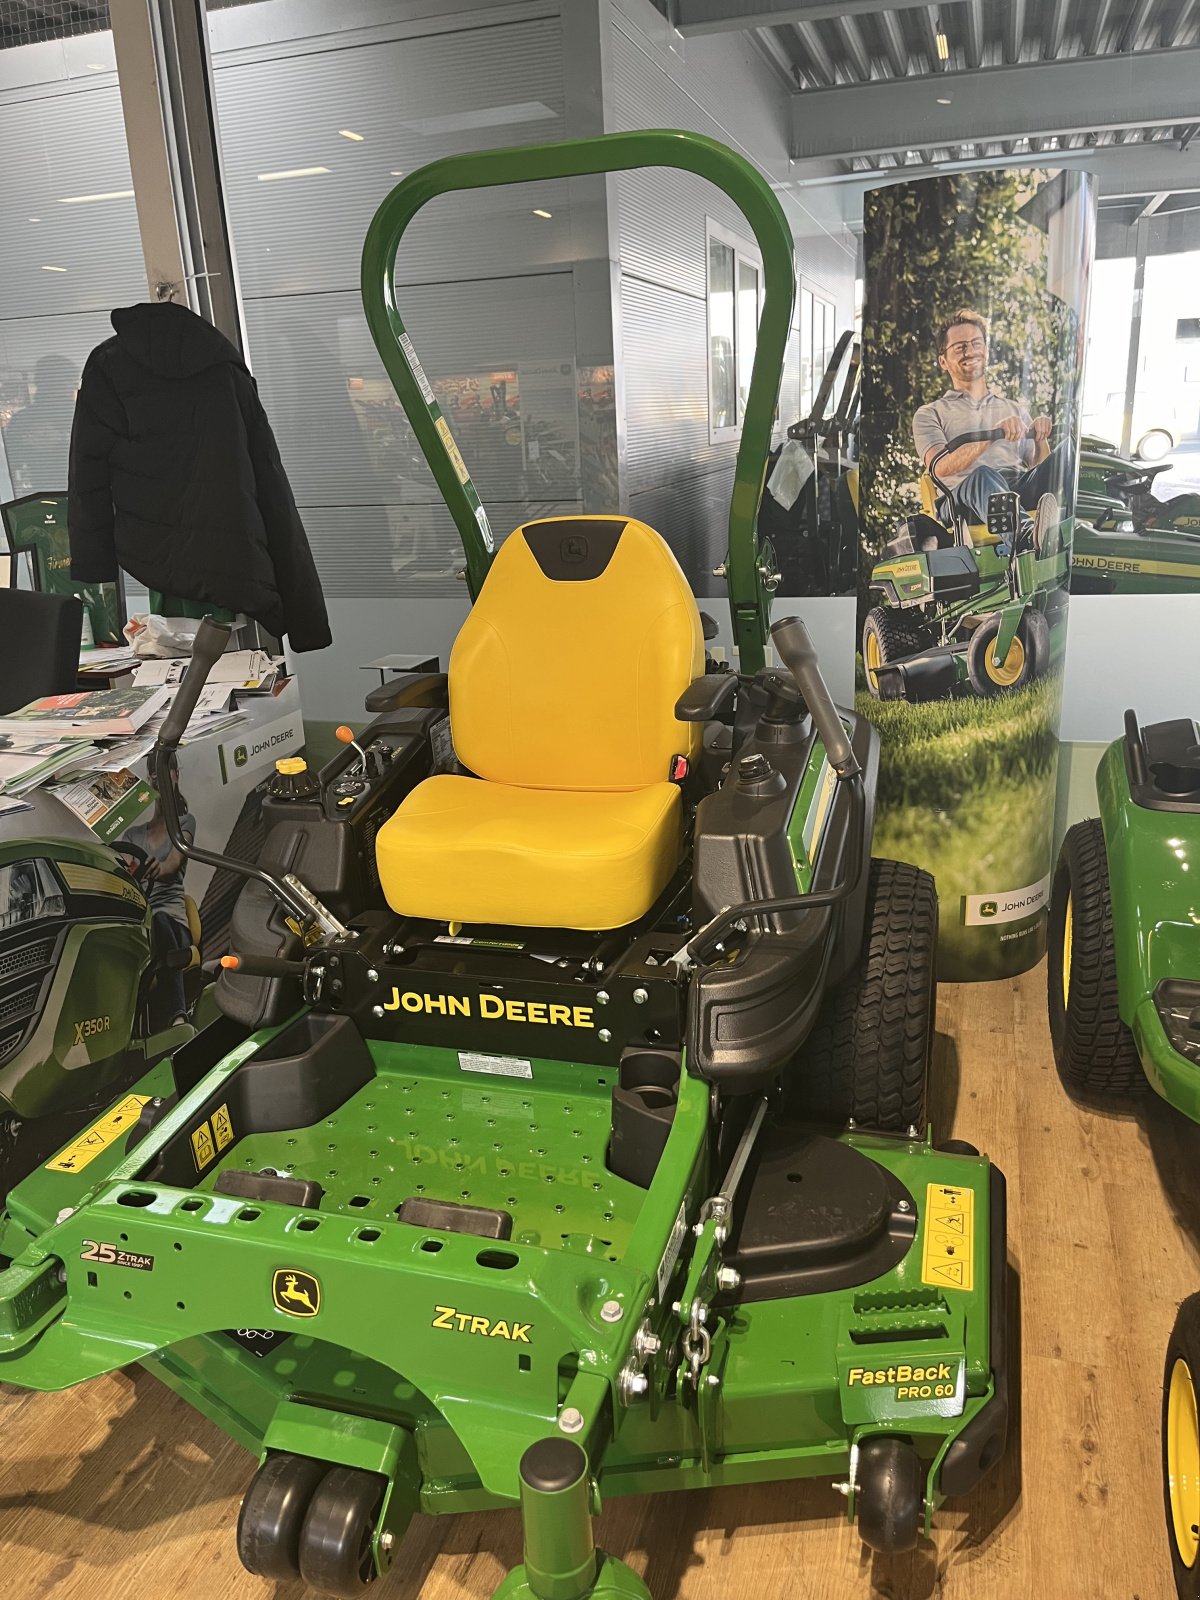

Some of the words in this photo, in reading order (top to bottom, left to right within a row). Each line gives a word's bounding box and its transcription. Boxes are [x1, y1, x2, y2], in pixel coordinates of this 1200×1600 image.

[1071, 557, 1094, 568] OHN
[1097, 558, 1141, 572] DEERE
[250, 739, 270, 756] JOHN
[270, 729, 294, 746] DEERE
[1001, 900, 1026, 912] JOHN
[383, 986, 471, 1017] JOHN
[479, 993, 595, 1028] DEERE
[80, 1239, 117, 1263] 25
[117, 1251, 151, 1265] ZTRAK
[432, 1305, 534, 1343] ZTRAK
[848, 1363, 952, 1386] FastBack
[897, 1385, 931, 1399] PRO
[934, 1384, 954, 1397] 60
